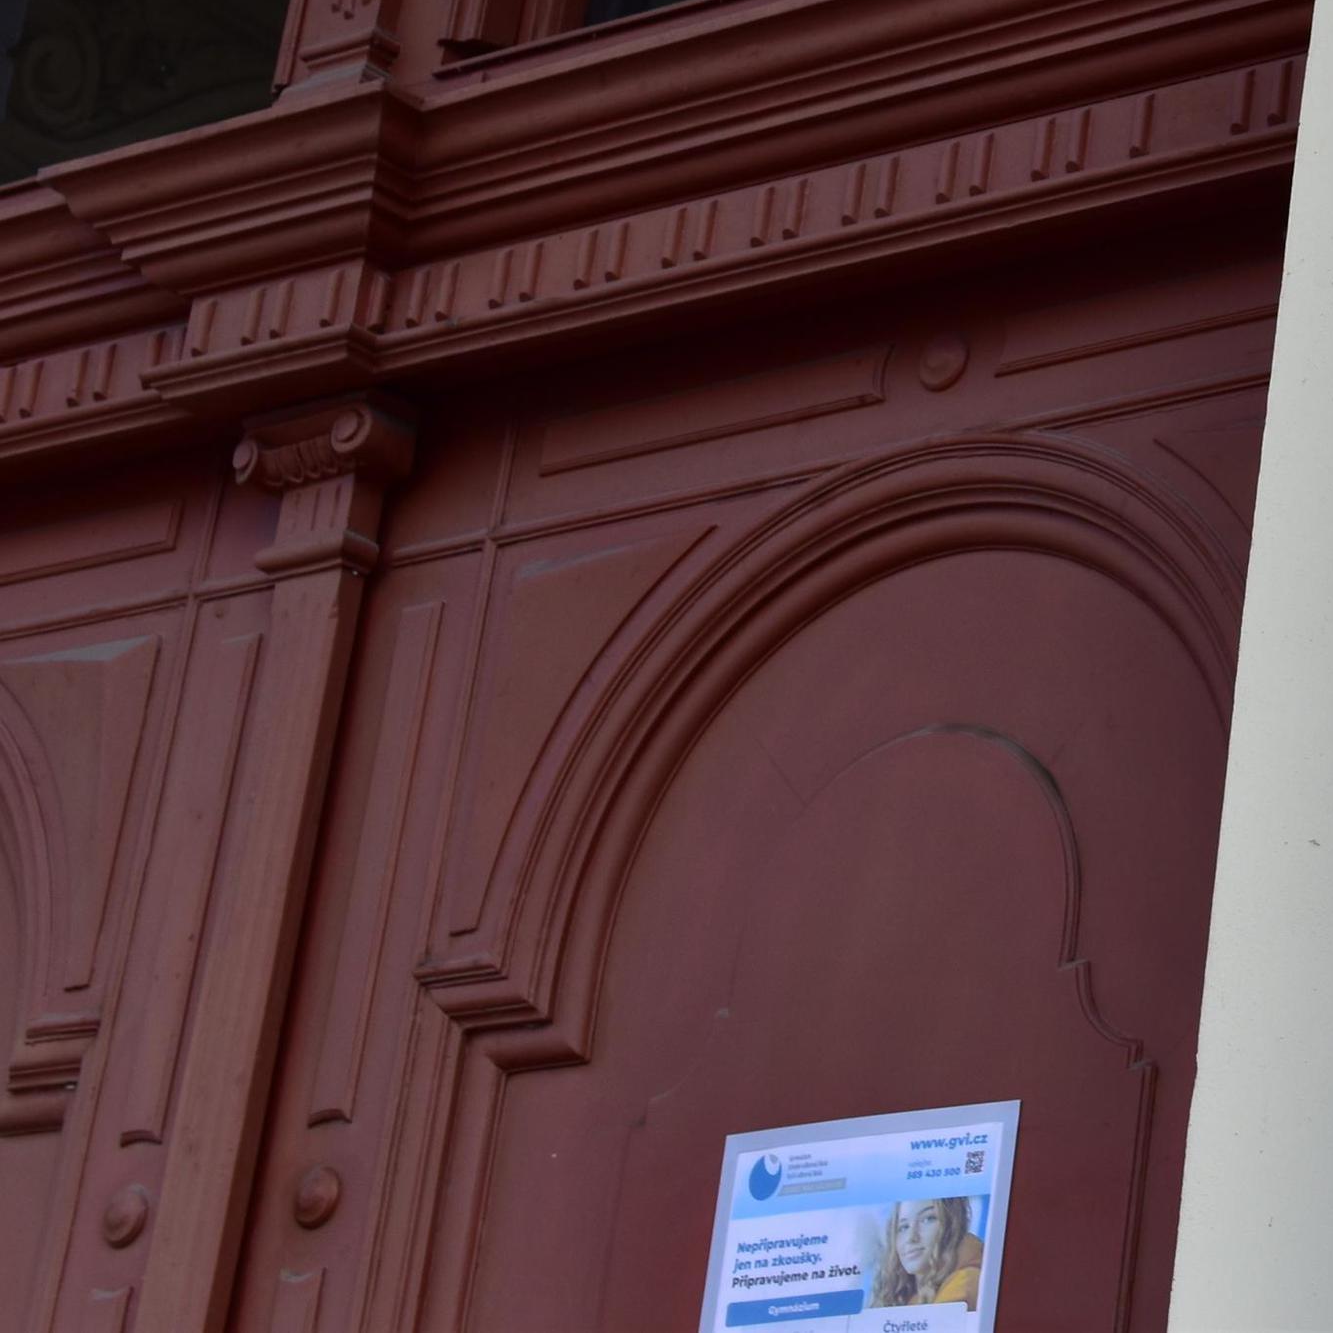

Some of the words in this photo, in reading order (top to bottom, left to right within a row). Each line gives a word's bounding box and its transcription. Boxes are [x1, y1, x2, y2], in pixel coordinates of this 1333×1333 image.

[736, 1233, 829, 1254] Nepřipravujeme
[732, 1258, 752, 1274] jen
[754, 1258, 769, 1269] na
[771, 1252, 823, 1266] zkoušky.
[731, 1271, 809, 1289] Připravujeme
[810, 1269, 825, 1280] na
[827, 1264, 862, 1279] život.
